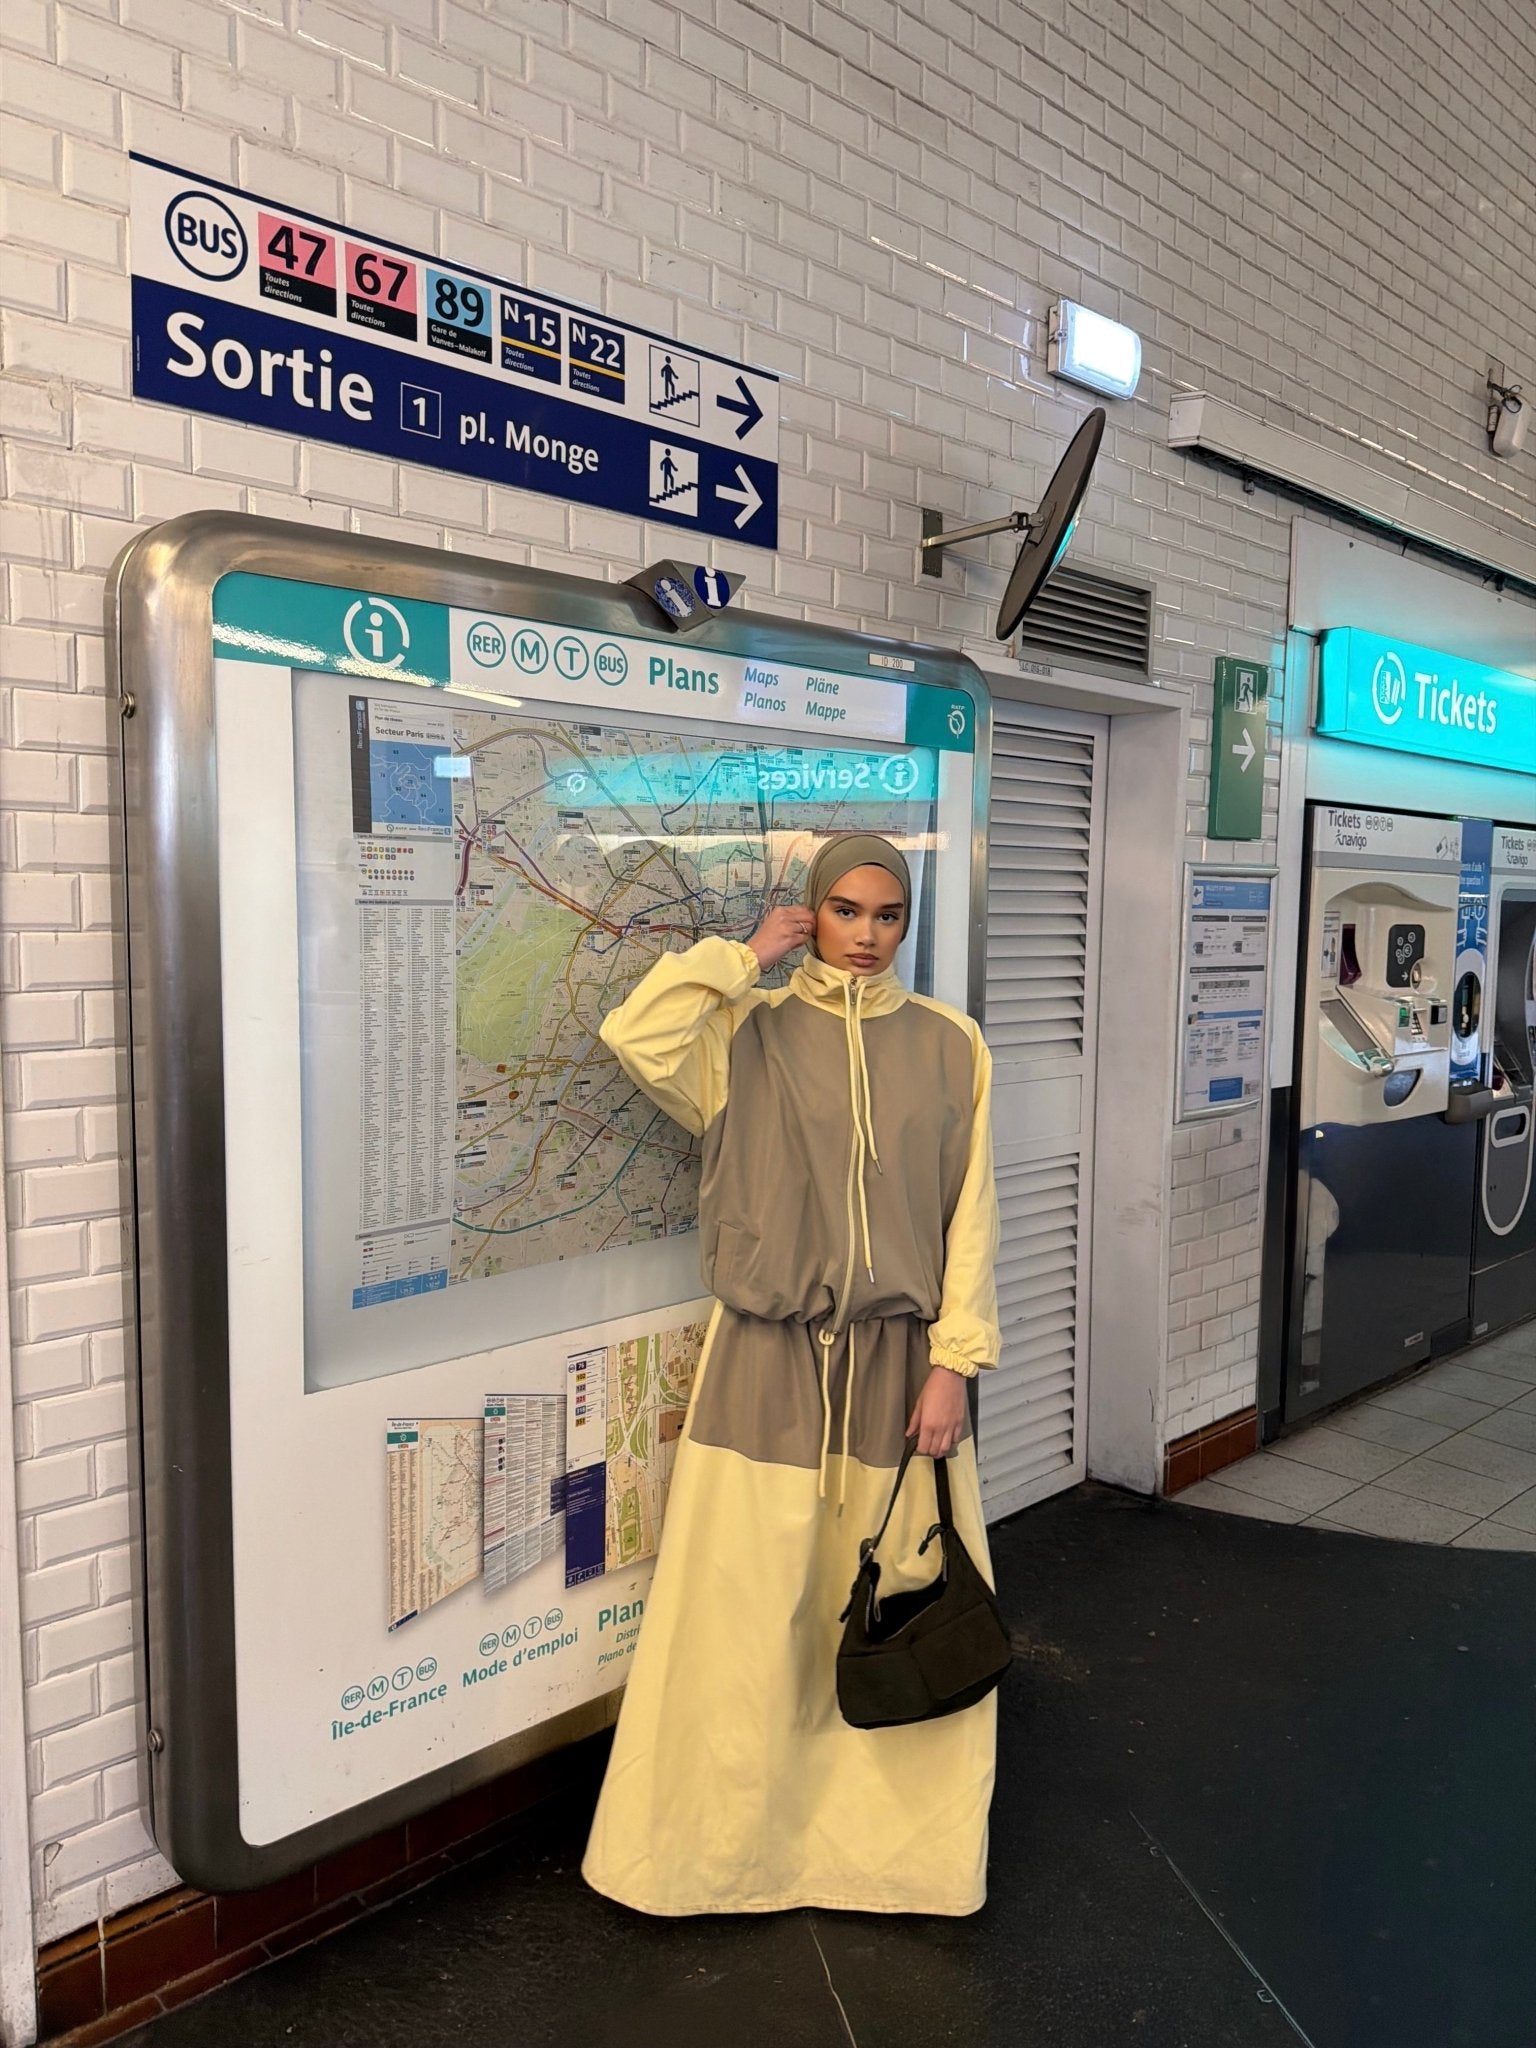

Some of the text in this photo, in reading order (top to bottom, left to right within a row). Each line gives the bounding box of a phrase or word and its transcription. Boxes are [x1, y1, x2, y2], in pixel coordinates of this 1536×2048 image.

[177, 212, 237, 259] BUS
[267, 225, 327, 277] 47
[354, 252, 408, 303] 67
[435, 278, 484, 328] 89
[264, 272, 290, 288] Toutes
[264, 284, 303, 303] directions
[351, 300, 374, 313] Toutes
[350, 311, 386, 328] directions
[431, 324, 457, 338] Gare de
[505, 347, 525, 359] Toutes
[504, 358, 535, 373] directions
[573, 368, 591, 380] Toutes
[166, 311, 375, 422] Sortie
[412, 397, 427, 427] 1
[460, 412, 496, 445] pl.
[505, 420, 600, 475] Monge
[572, 379, 600, 393] directions
[472, 634, 720, 695] RER M T BUS Plans
[744, 667, 840, 696] Maps Pläne
[744, 691, 847, 722] Planos Mappe
[1414, 671, 1498, 734] Tickets
[375, 726, 405, 736] Secteur
[405, 730, 425, 739] Paris
[1328, 810, 1361, 829] Tickets
[1340, 832, 1367, 850] navigo
[1501, 836, 1525, 850] Tickets
[481, 1612, 561, 1652] RER M T BUS
[615, 1623, 640, 1643] Distri
[462, 1628, 579, 1688] Mode d’emploi
[597, 1648, 624, 1666] Plano
[343, 1662, 435, 1705] RER M T BUS
[331, 1684, 448, 1741] Île-de-France
